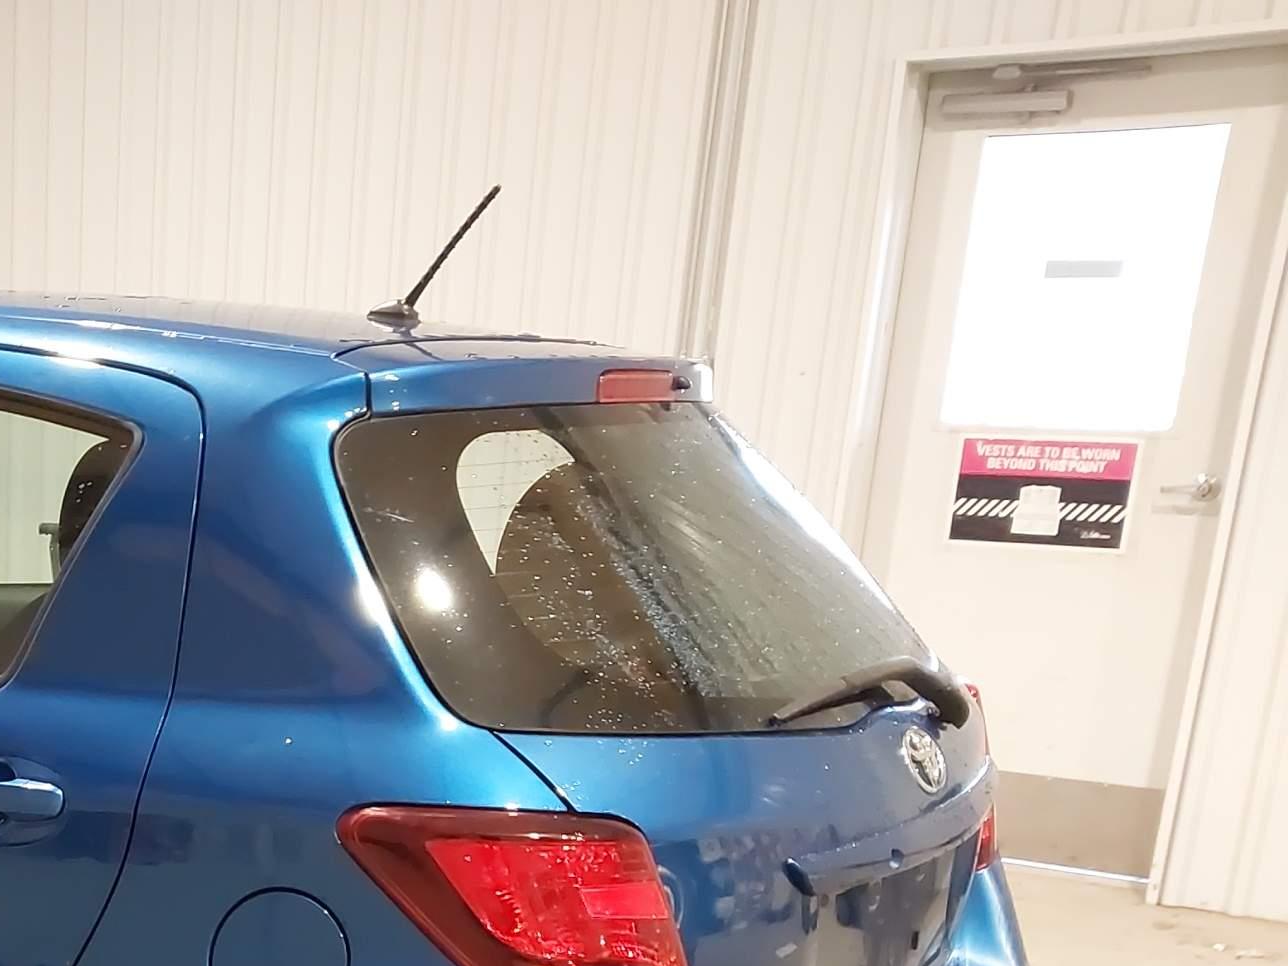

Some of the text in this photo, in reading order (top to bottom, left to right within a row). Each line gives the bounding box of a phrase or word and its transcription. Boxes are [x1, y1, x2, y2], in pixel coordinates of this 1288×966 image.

[977, 442, 1015, 457] VESTS
[1016, 446, 1042, 458] ARE
[1044, 446, 1060, 458] TO
[1081, 448, 1121, 460] WORN
[986, 457, 1108, 473] BEYOND THIS POINT
